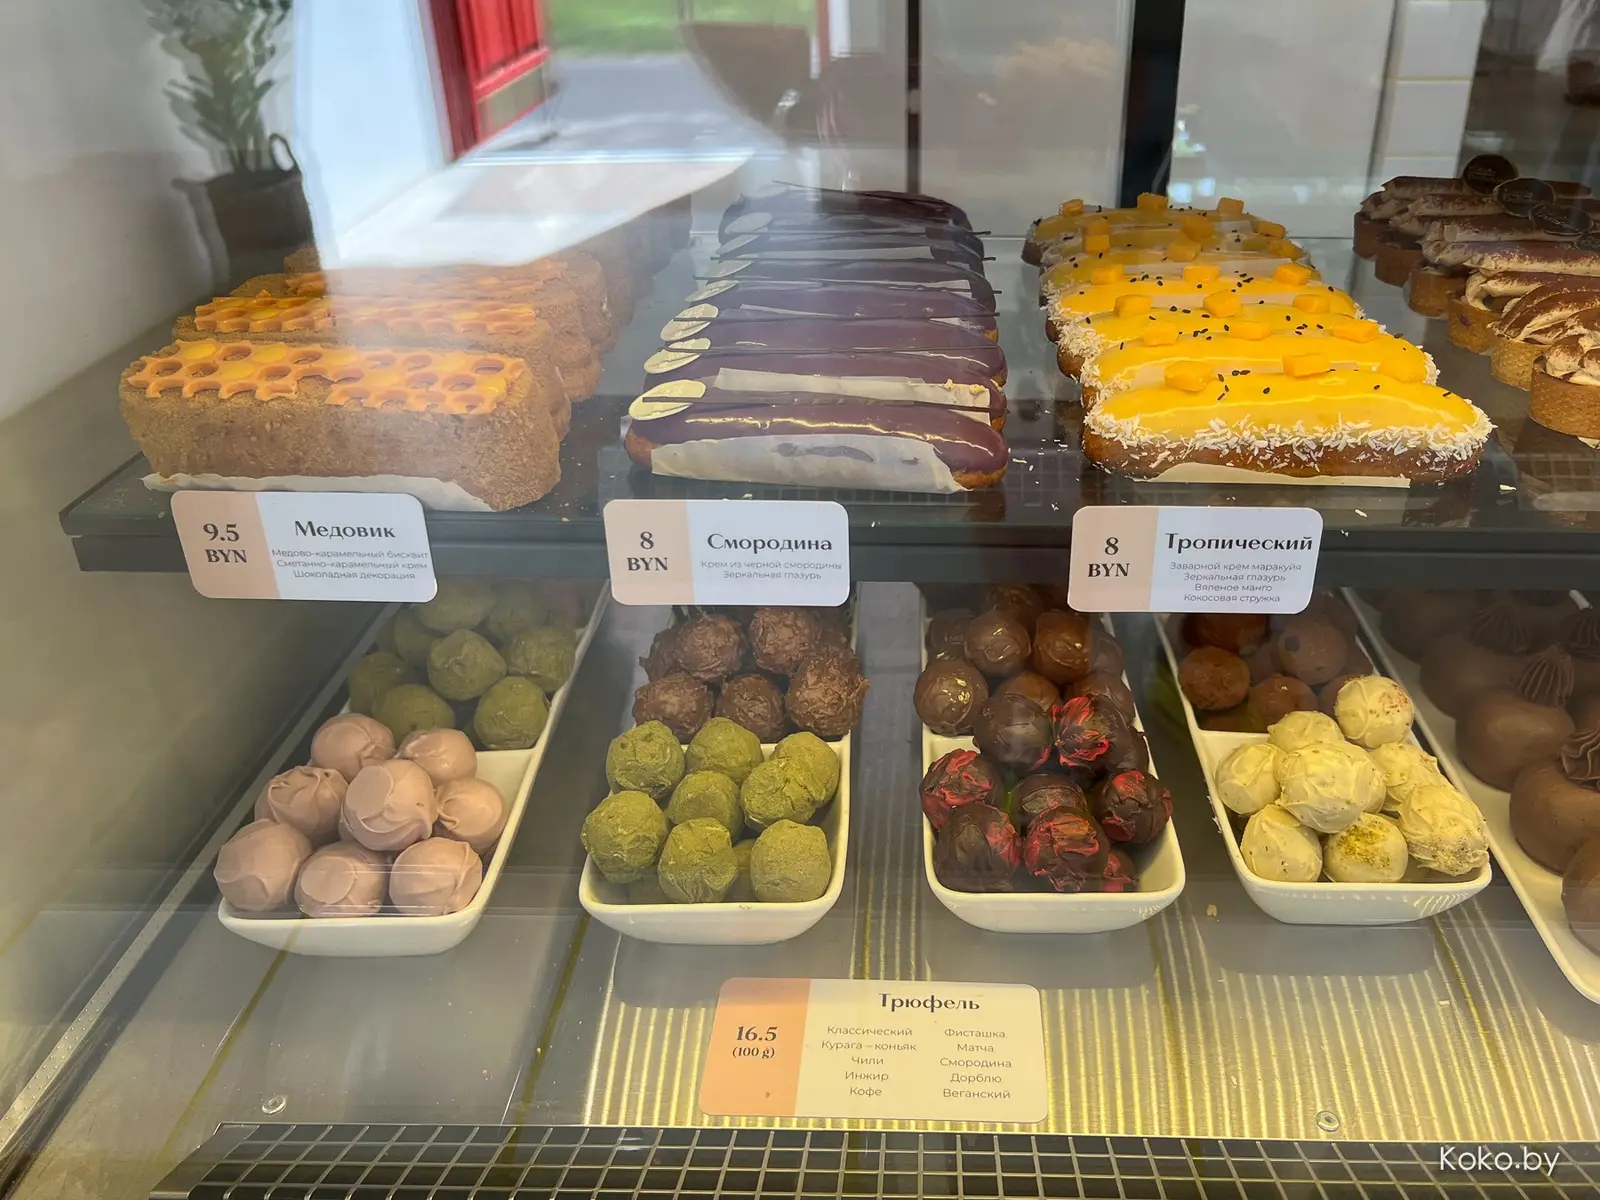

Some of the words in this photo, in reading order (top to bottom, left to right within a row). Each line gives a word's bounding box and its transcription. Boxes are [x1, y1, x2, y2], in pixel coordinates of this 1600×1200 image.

[203, 523, 240, 542] 9.5
[294, 520, 396, 539] Медовик
[640, 531, 655, 550] 8
[707, 533, 833, 554] Смородина
[1104, 536, 1119, 555] 8
[1165, 532, 1313, 554] Тропический
[204, 549, 248, 564] BYN
[271, 549, 385, 559] Медово-карамельный
[386, 550, 428, 559] бисквит
[276, 559, 400, 569] Сметанно-карамельный
[401, 562, 428, 570] крем
[626, 557, 669, 571] BYN
[701, 561, 728, 570] Крем
[730, 561, 742, 569] из
[743, 560, 782, 570] черной
[783, 562, 842, 571] смородины
[1088, 563, 1130, 577] BYN
[1170, 561, 1221, 571] Заварной
[1223, 563, 1250, 572] крем
[1251, 563, 1302, 572] маракуйя
[293, 570, 358, 579] Шоколадная
[359, 572, 416, 580] декорация
[723, 570, 782, 580] Зеркальная
[783, 572, 822, 581] глазурь
[1184, 572, 1245, 582] Зеркальная
[1246, 574, 1286, 582] глазурь
[1194, 583, 1239, 592] Вяленое
[1242, 584, 1273, 592] манго
[1184, 594, 1238, 602] Кокосовая
[1239, 595, 1281, 603] стружка
[878, 992, 980, 1013] Трюфель
[736, 1025, 778, 1042] 16.5
[827, 1025, 913, 1037] Классический
[944, 1028, 1006, 1039] Фисташка
[821, 1040, 864, 1052] Курага
[875, 1042, 917, 1051] коньяк
[957, 1043, 994, 1053] Матча
[732, 1046, 760, 1058] (100
[761, 1047, 776, 1059] g)
[851, 1055, 885, 1066] Чили
[939, 1057, 1012, 1070] Смородина
[845, 1071, 889, 1082] Инжир
[950, 1073, 1002, 1084] Дорблю
[849, 1086, 883, 1098] Кофе
[943, 1088, 1011, 1099] Веганский
